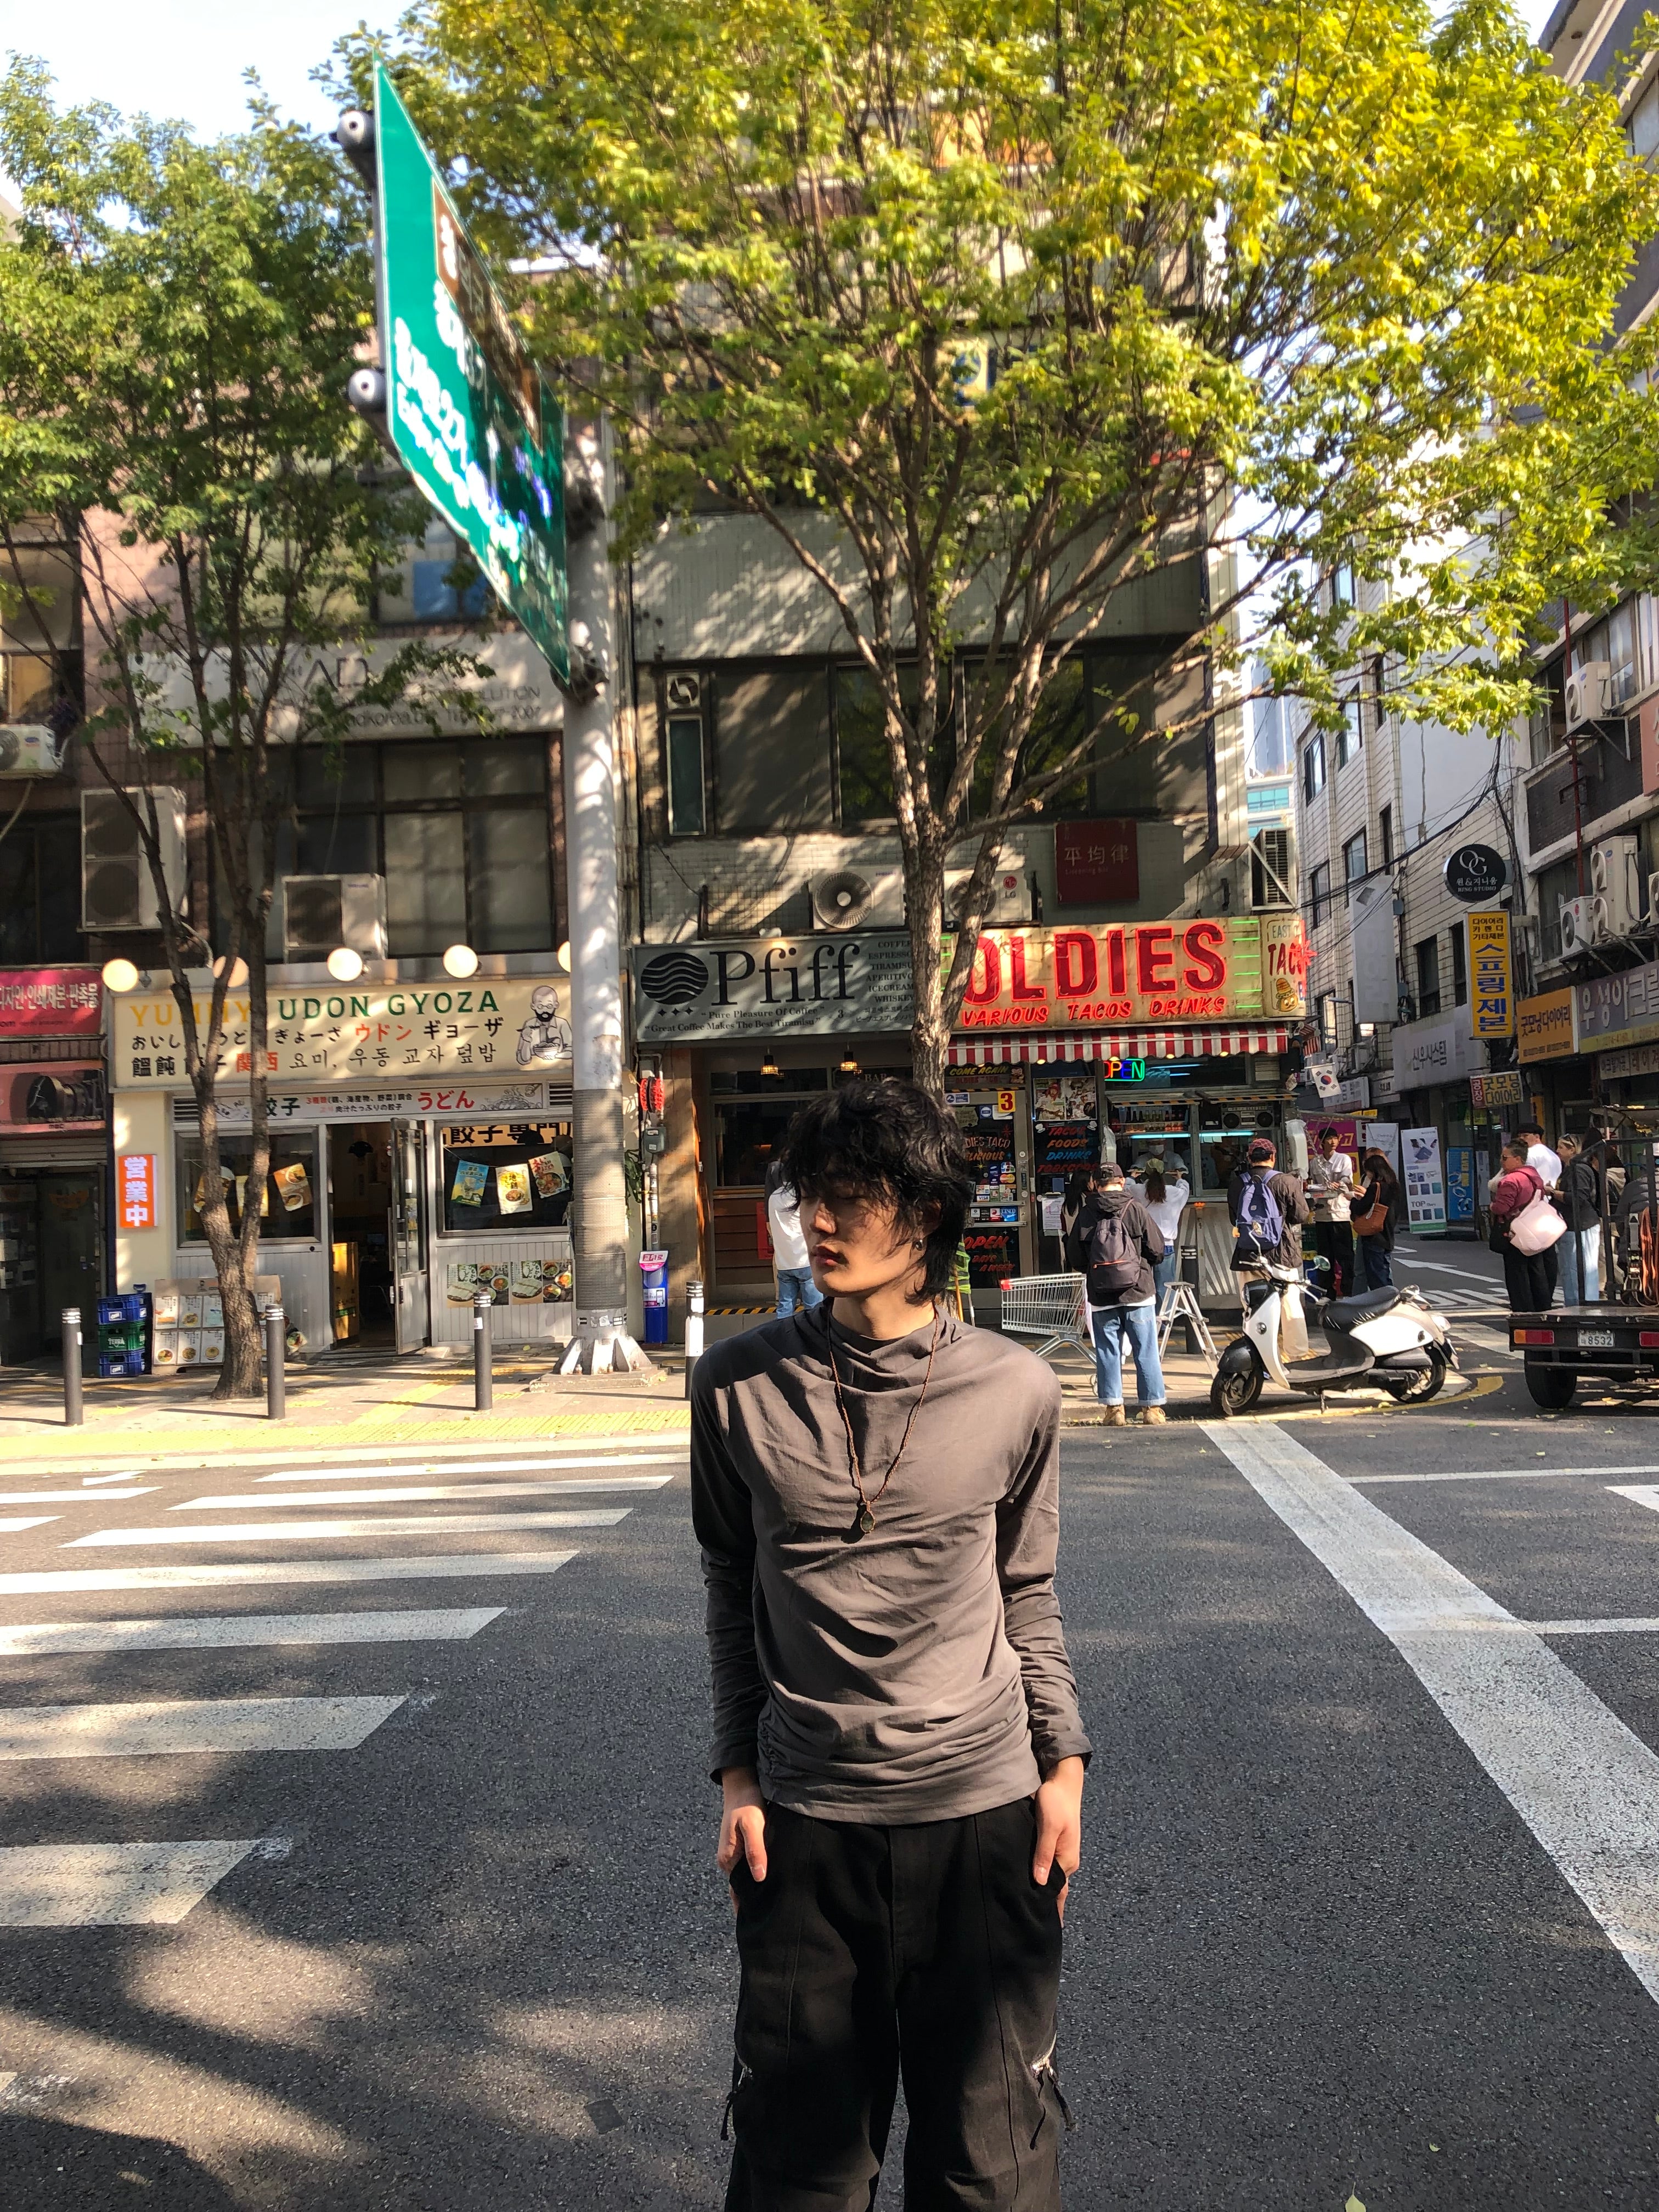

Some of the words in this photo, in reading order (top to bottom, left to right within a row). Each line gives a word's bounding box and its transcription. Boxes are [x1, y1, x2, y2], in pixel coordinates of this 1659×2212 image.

[1064, 843, 1130, 867] 平均律
[963, 921, 1227, 1006] OLDIES
[710, 943, 861, 1006] Pfiff
[277, 996, 371, 1020] UDON
[388, 990, 500, 1015] GYOZA
[962, 1005, 1049, 1027] VARIOUS
[1067, 1000, 1132, 1021] TACOS
[1150, 996, 1228, 1017] DRINKS
[356, 1023, 412, 1043] ウドン
[424, 1017, 504, 1040] ギョーザ
[348, 1047, 391, 1068] 우동
[402, 1045, 444, 1065] 교자
[456, 1042, 496, 1064] 덮밥
[950, 1068, 978, 1076] COME
[1483, 1074, 1519, 1092] 굿모닝
[418, 1091, 475, 1110] うどん
[1001, 1093, 1013, 1111] 3
[1047, 1138, 1088, 1148] FOODS
[1046, 1151, 1092, 1161] DRINKS
[125, 1157, 148, 1227] 営業中
[964, 1236, 1009, 1250] OPEN
[1588, 1336, 1612, 1345] 8532
